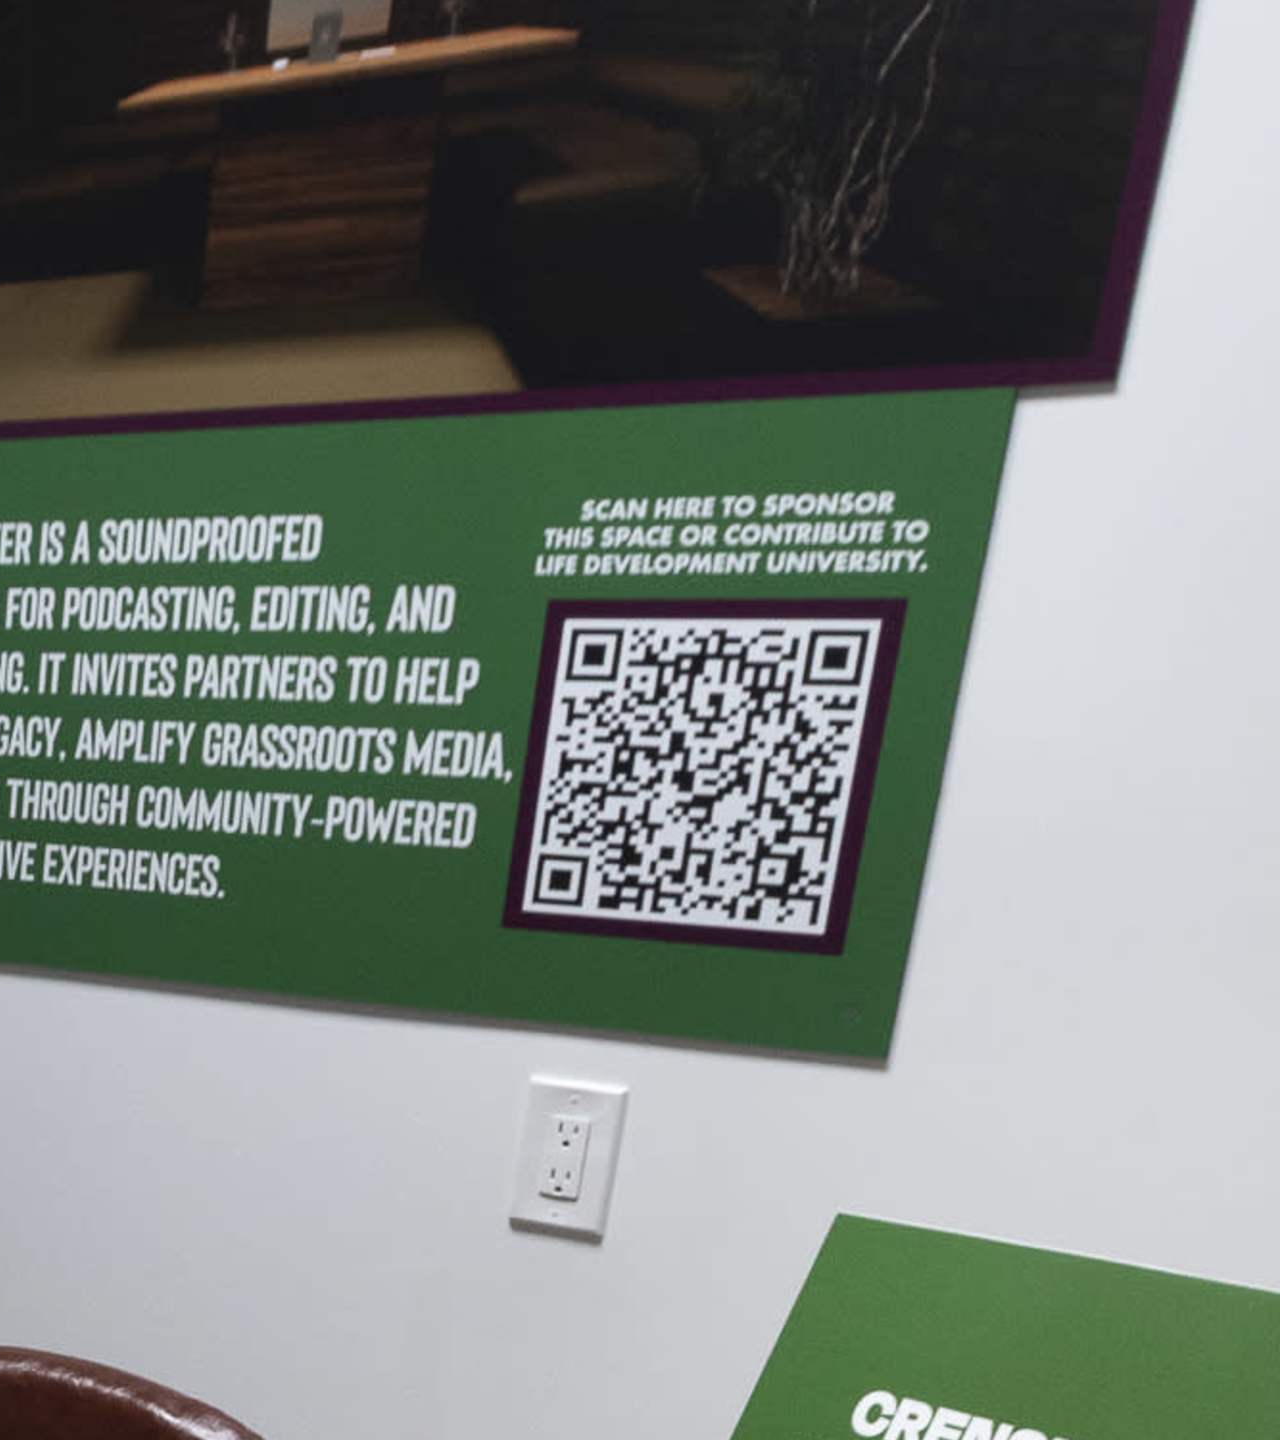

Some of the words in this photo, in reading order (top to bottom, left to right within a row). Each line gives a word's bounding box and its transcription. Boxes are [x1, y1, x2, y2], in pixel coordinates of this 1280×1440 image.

[580, 498, 646, 521] SCAN
[653, 495, 715, 519] HERE
[721, 494, 755, 517] TO
[762, 490, 894, 517] SPONSOR
[39, 520, 64, 565] IS
[71, 520, 89, 564] A
[98, 514, 322, 564] SOUNDPROOFED
[543, 526, 593, 549] THIS
[599, 525, 672, 548] SPACE
[679, 524, 715, 547] OR
[723, 520, 883, 546] CONTRIBUTE
[892, 519, 929, 543] TO
[534, 554, 576, 576] LIFE
[582, 551, 759, 575] DEVELOPMENT
[766, 549, 927, 573] UNIVERSITY.
[5, 587, 54, 630] FOR
[62, 585, 240, 634] PODCASTING,
[250, 585, 375, 635] EDITING,
[386, 584, 455, 632] AND
[37, 652, 65, 694] IT
[71, 653, 175, 697] INVITES
[183, 654, 336, 702] PARTNERS
[346, 657, 385, 702] TO
[393, 657, 479, 705] HELP
[75, 718, 195, 763] AMPLIFY
[202, 721, 395, 774] GRASSROOTS
[402, 730, 512, 783] MEDIA,
[7, 778, 128, 825] THROUGH
[136, 785, 476, 848] COMMUNITY-POWERED
[43, 844, 224, 897] EXPERIENCES.
